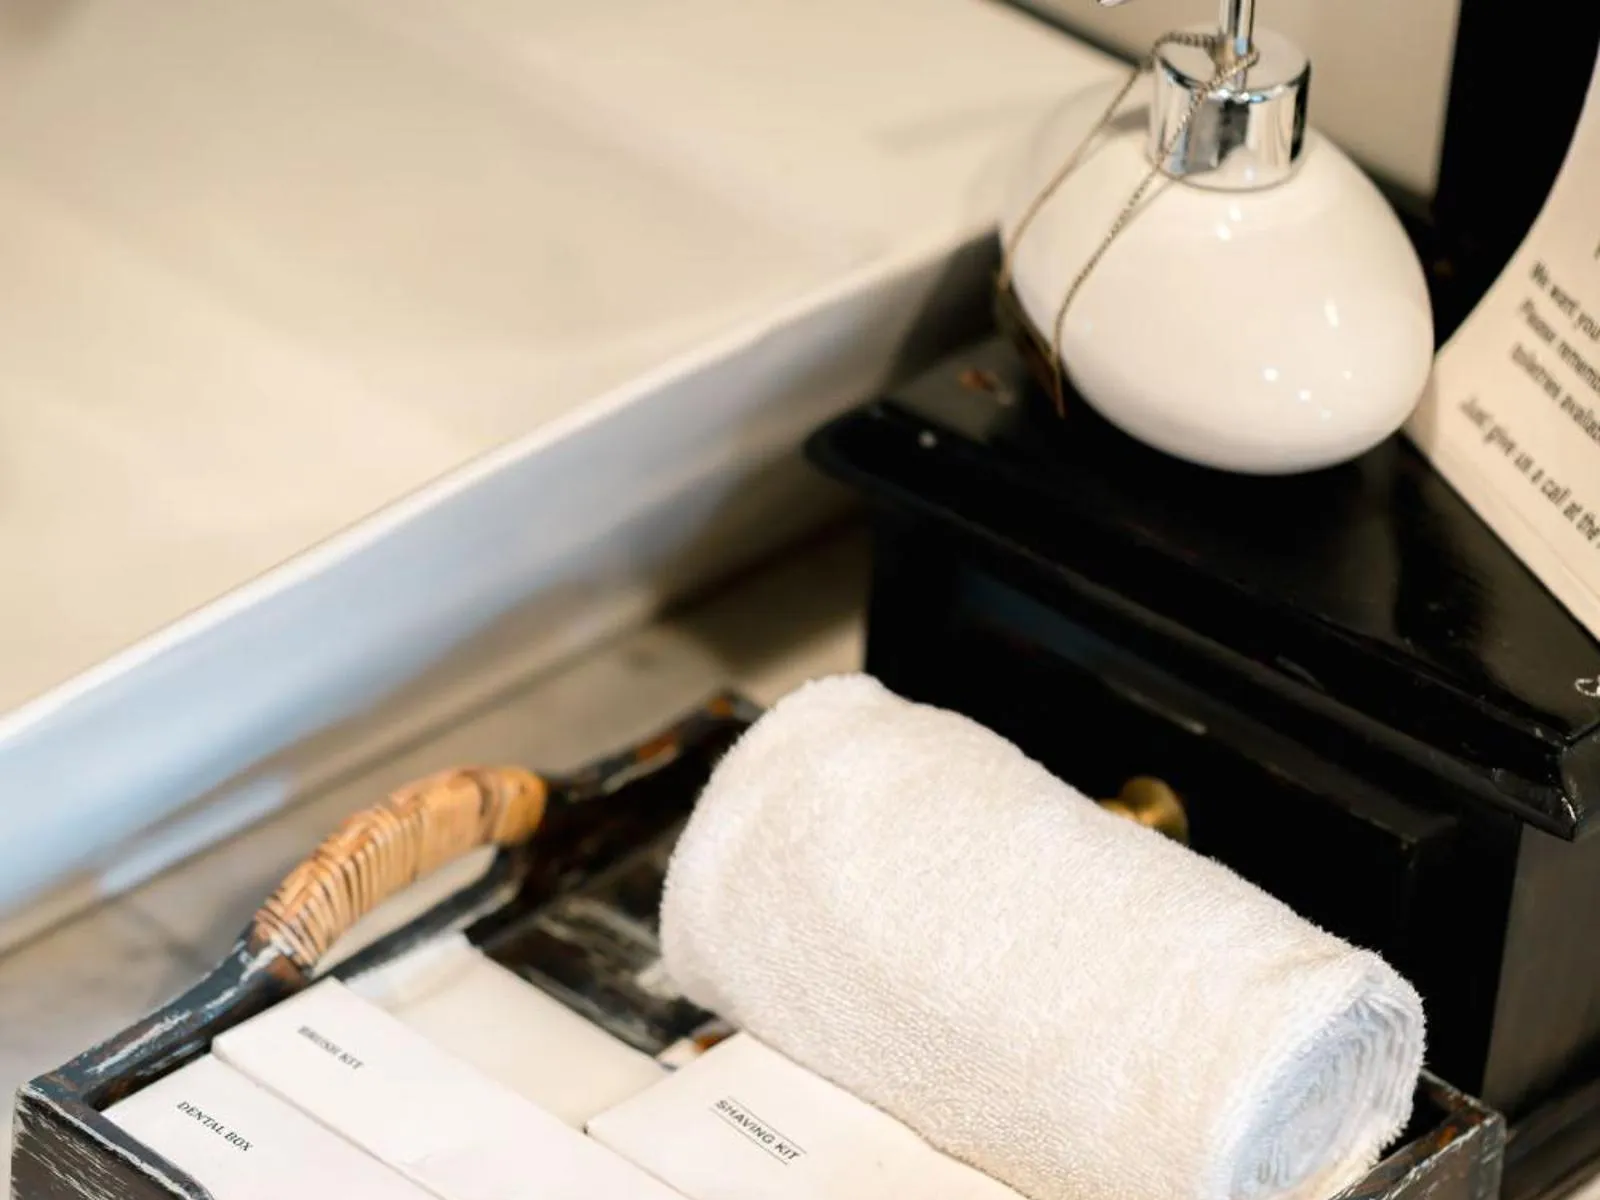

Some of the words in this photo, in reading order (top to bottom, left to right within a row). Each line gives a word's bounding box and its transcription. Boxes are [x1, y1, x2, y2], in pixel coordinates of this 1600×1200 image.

[338, 1052, 365, 1070] KIT
[176, 1101, 224, 1135] DENTAL
[224, 1131, 253, 1151] BOX
[715, 1100, 776, 1144] SHAVING
[775, 1143, 800, 1160] KIT
